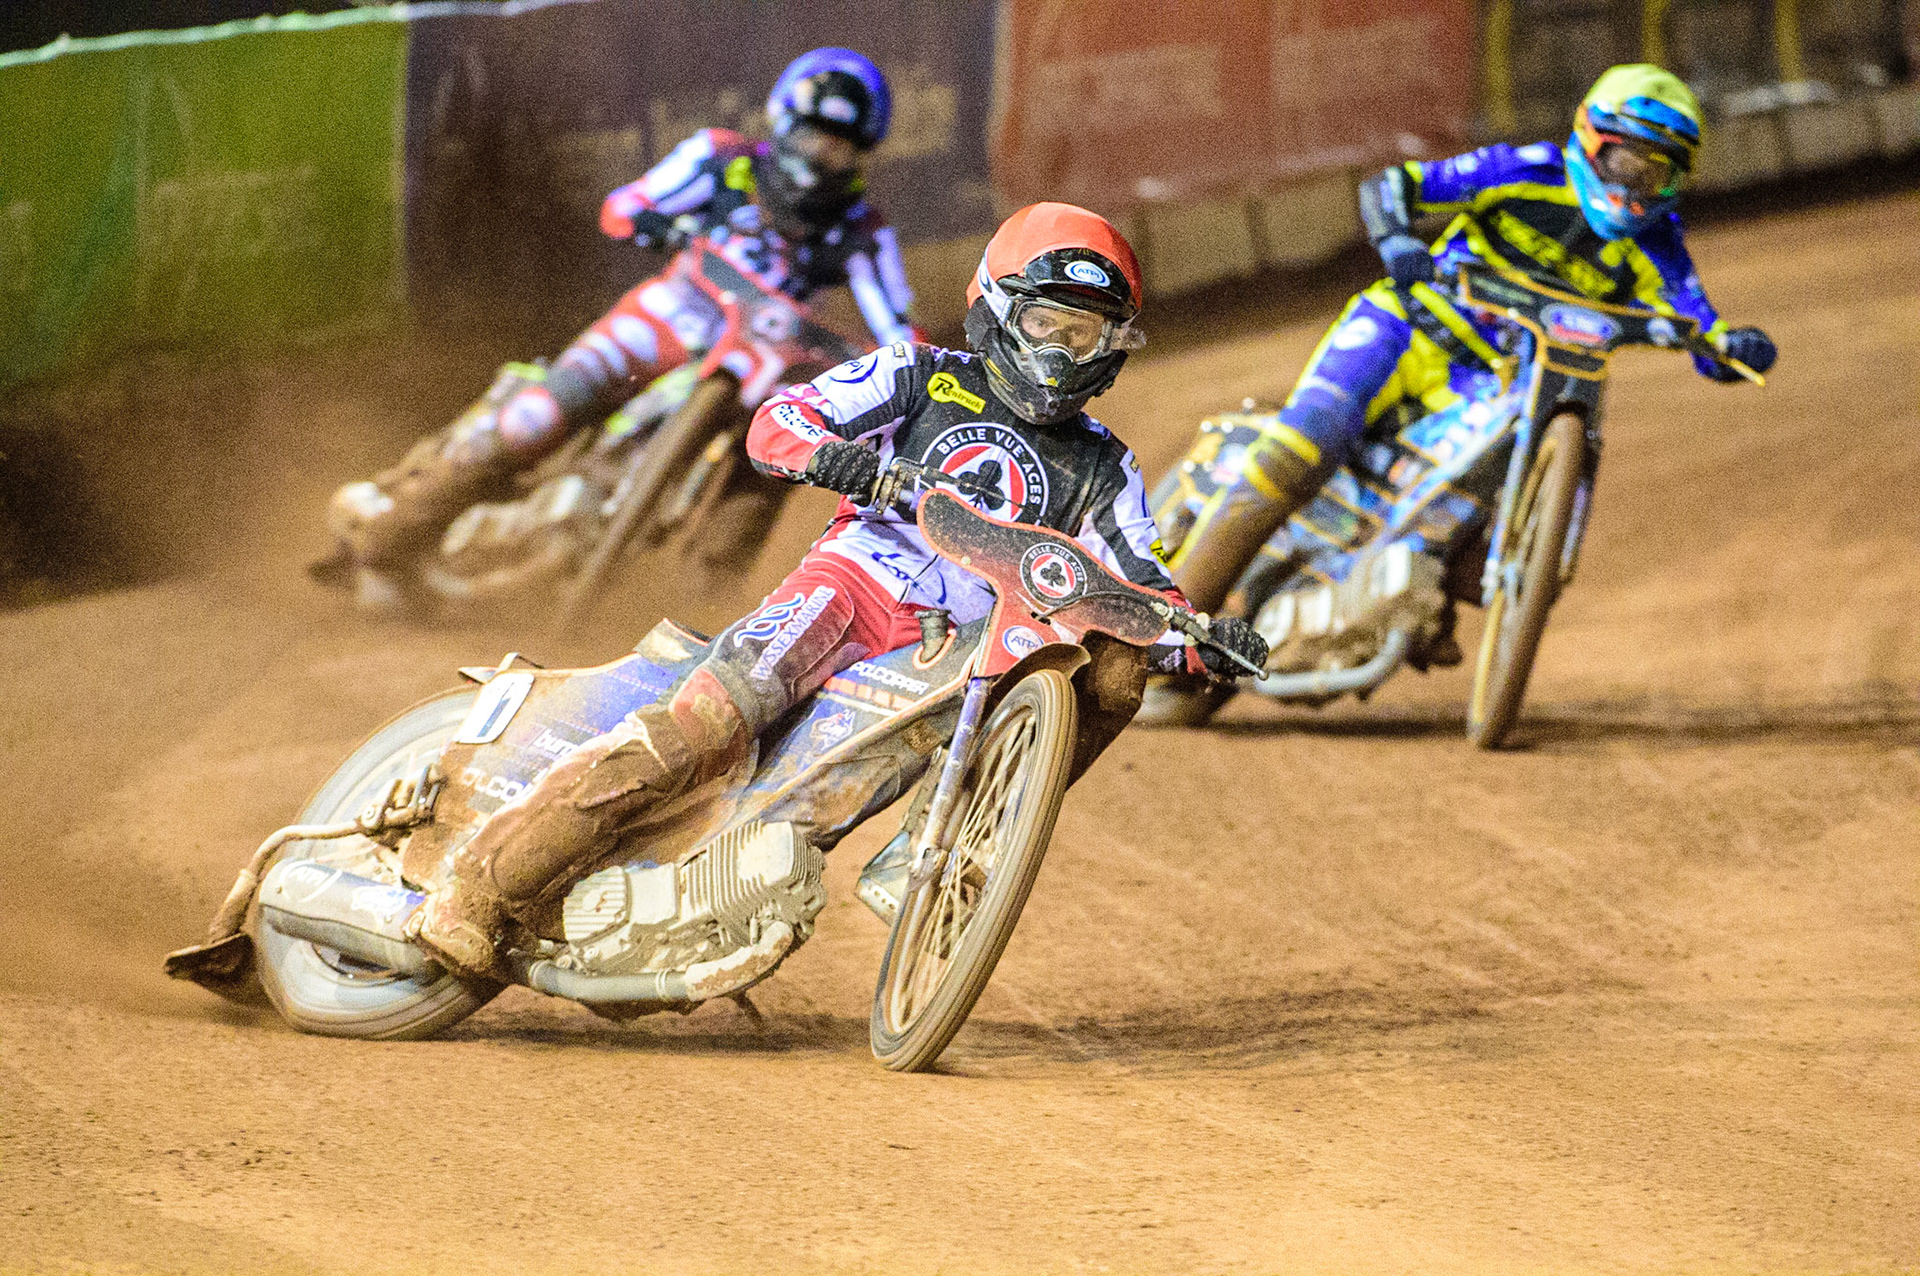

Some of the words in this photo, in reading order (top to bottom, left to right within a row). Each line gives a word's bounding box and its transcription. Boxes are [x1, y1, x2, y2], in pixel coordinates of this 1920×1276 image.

[937, 428, 987, 455] BELLE
[995, 430, 1025, 458] VUE
[1021, 463, 1042, 505] ACES
[1028, 545, 1051, 561] BELLE
[1054, 547, 1071, 561] VUE
[1070, 561, 1084, 582] ACES
[849, 662, 929, 695] POLCOPPER
